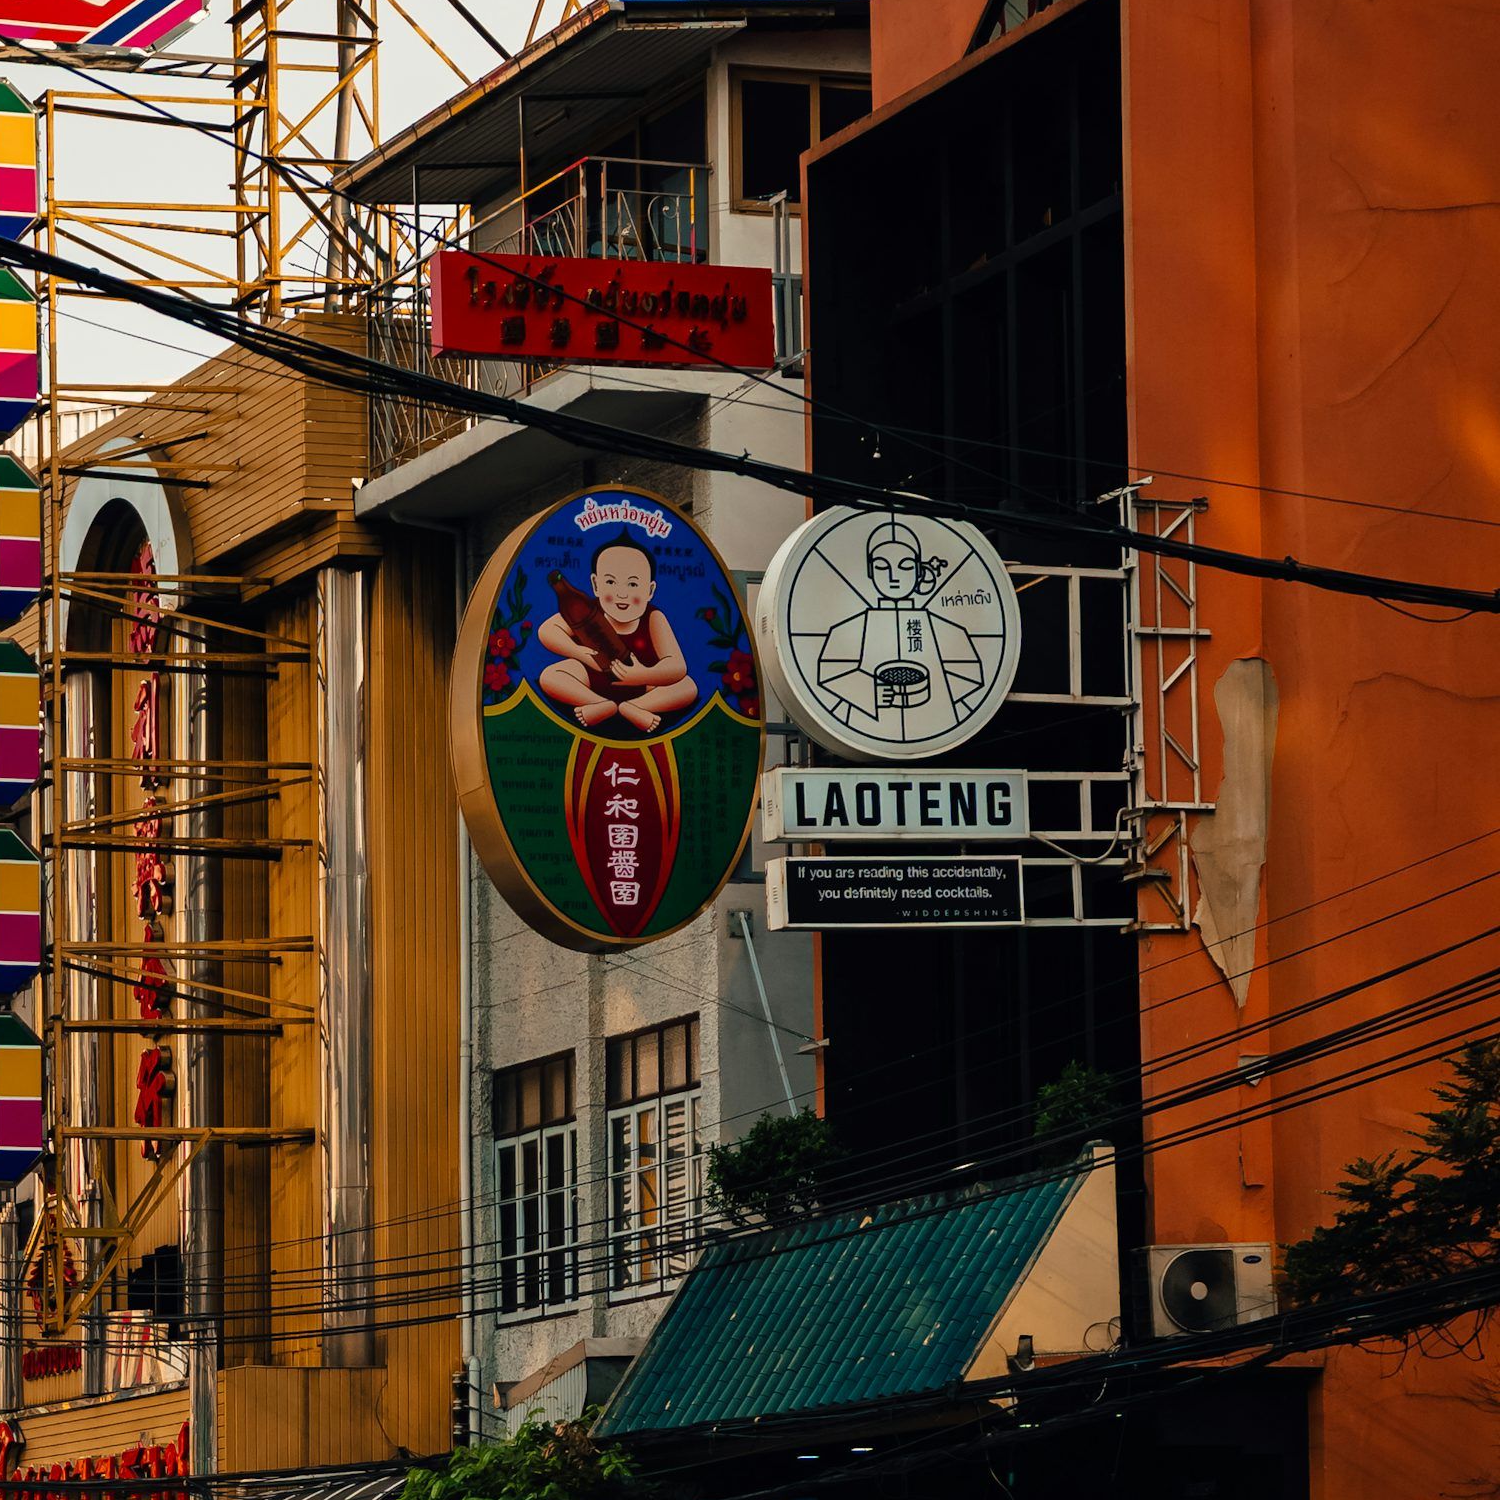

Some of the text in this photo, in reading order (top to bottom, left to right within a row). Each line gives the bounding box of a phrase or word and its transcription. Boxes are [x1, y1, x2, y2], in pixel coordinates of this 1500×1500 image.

[906, 618, 924, 653] 楼顶
[794, 781, 1014, 828] LAOTENG
[798, 865, 1007, 882] If you are reading this accidentally,
[818, 886, 993, 902] you definitely need cocktails.
